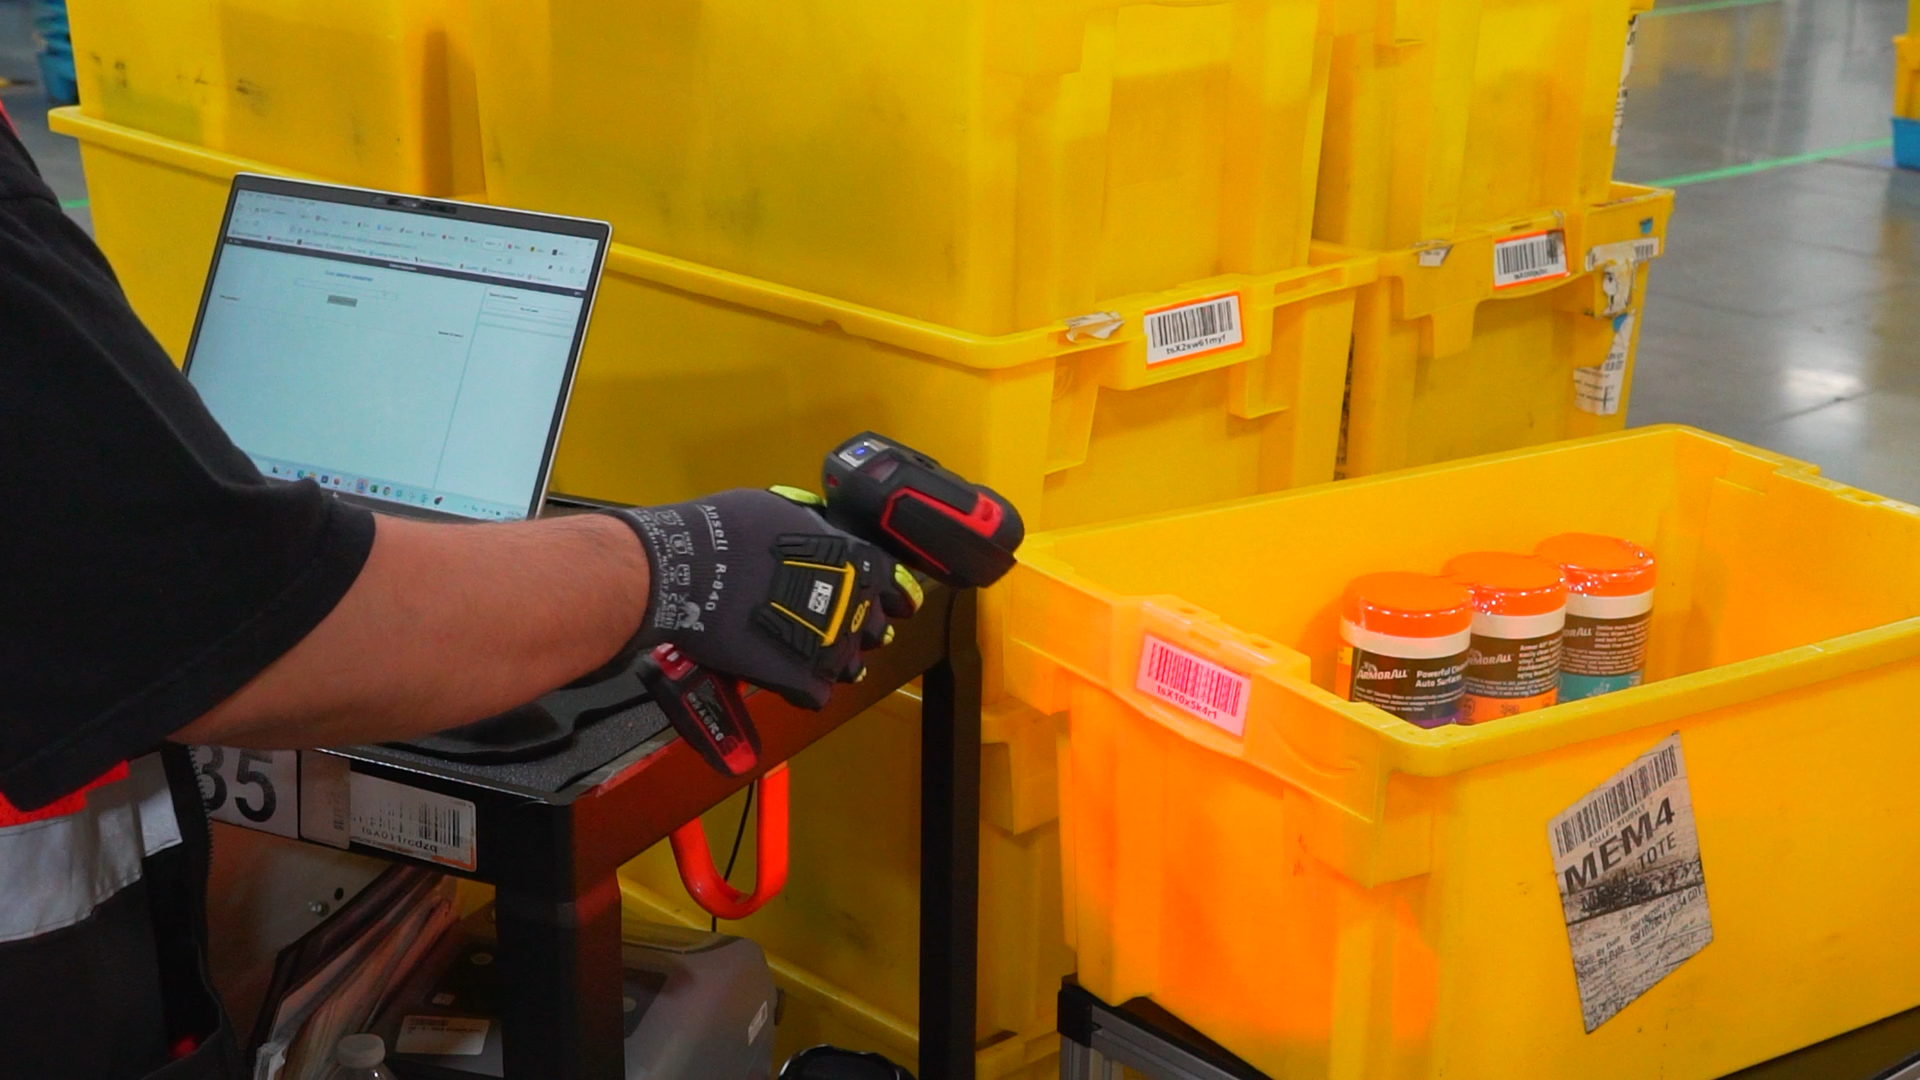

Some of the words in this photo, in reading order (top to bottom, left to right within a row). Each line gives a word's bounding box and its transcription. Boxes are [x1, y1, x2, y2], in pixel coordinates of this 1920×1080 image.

[702, 504, 729, 550] Ansell
[705, 563, 727, 611] R-840
[1415, 679, 1435, 687] Auto
[1416, 667, 1451, 678] Powerful
[1563, 797, 1675, 896] MEM4
[1636, 830, 1676, 873] TOTE
